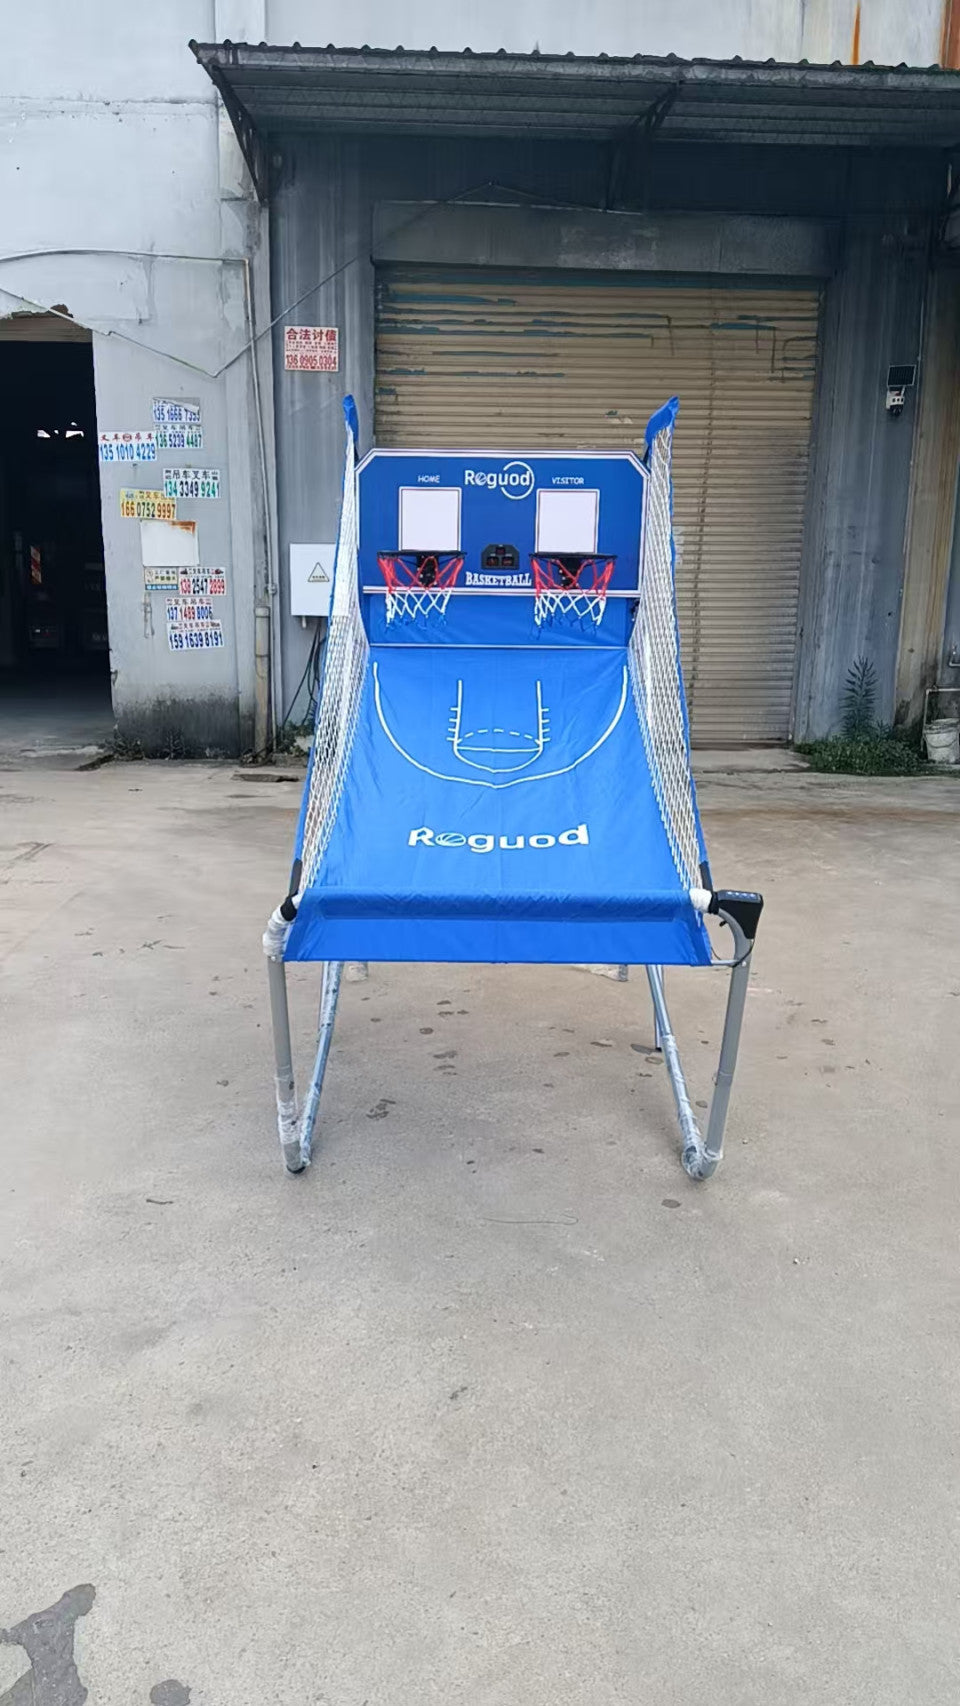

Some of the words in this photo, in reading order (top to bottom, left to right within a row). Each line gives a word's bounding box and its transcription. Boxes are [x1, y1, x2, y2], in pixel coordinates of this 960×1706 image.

[100, 443, 114, 460] 135
[116, 443, 134, 460] 1010
[136, 443, 156, 460] 4229
[418, 475, 440, 483] HOME
[164, 481, 178, 497] 134
[180, 481, 199, 497] 3349
[121, 501, 135, 517] 166
[136, 502, 156, 517] 0752
[157, 503, 176, 518] 9997
[465, 571, 532, 587] BASKETBALL
[169, 633, 184, 649] 159
[184, 631, 204, 648] 1639
[204, 631, 223, 647] 8191
